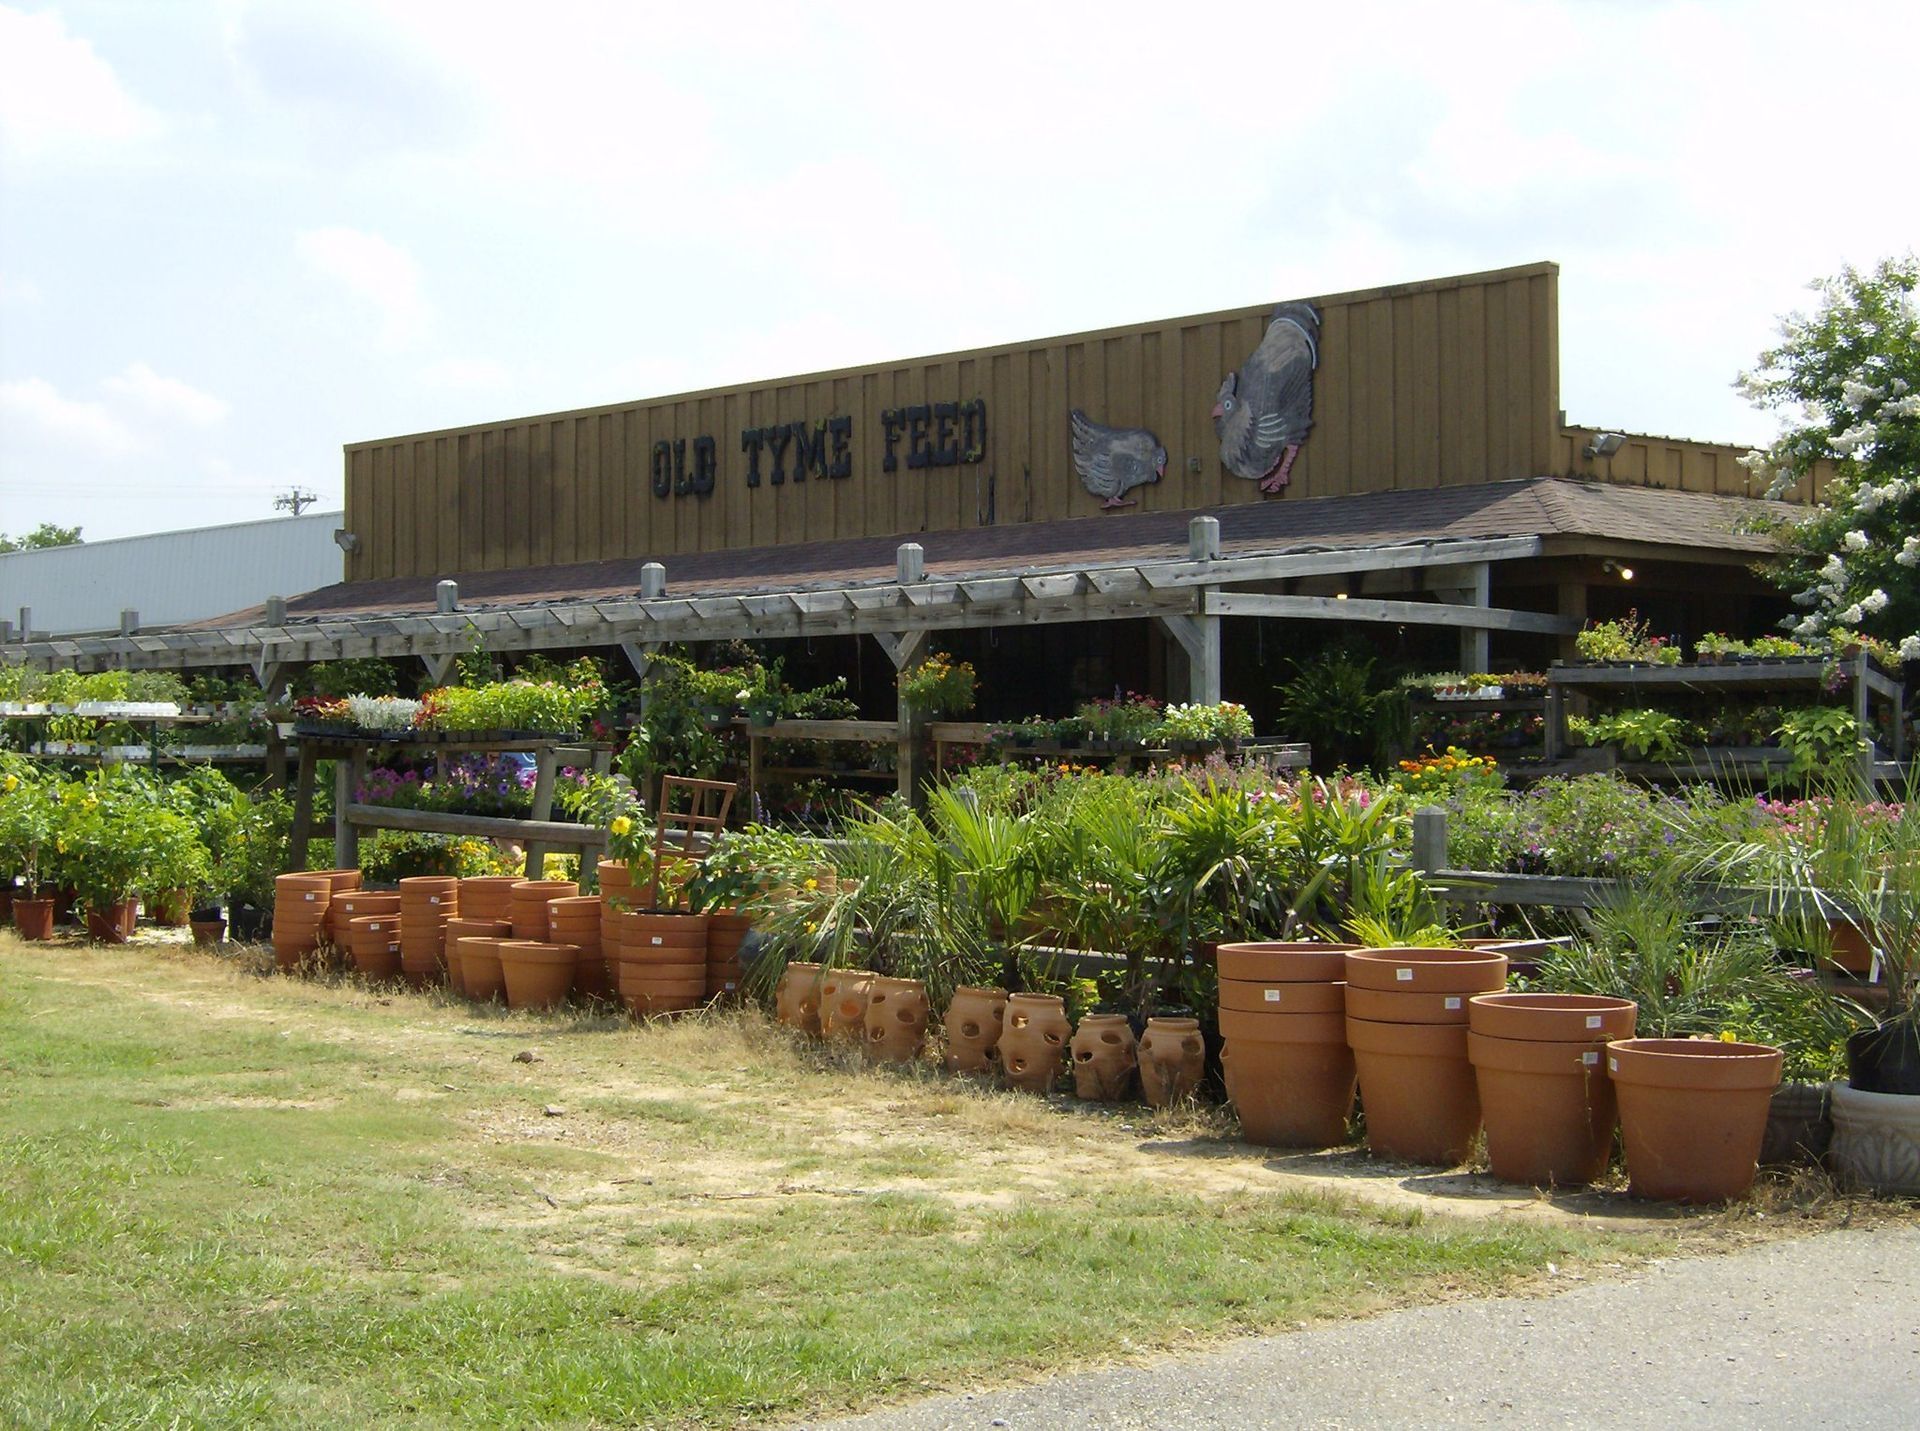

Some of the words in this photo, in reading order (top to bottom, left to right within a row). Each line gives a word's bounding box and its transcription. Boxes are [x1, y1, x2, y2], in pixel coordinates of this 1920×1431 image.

[652, 435, 716, 499] OLD
[741, 415, 852, 488] TYME
[881, 398, 987, 473] FEED
